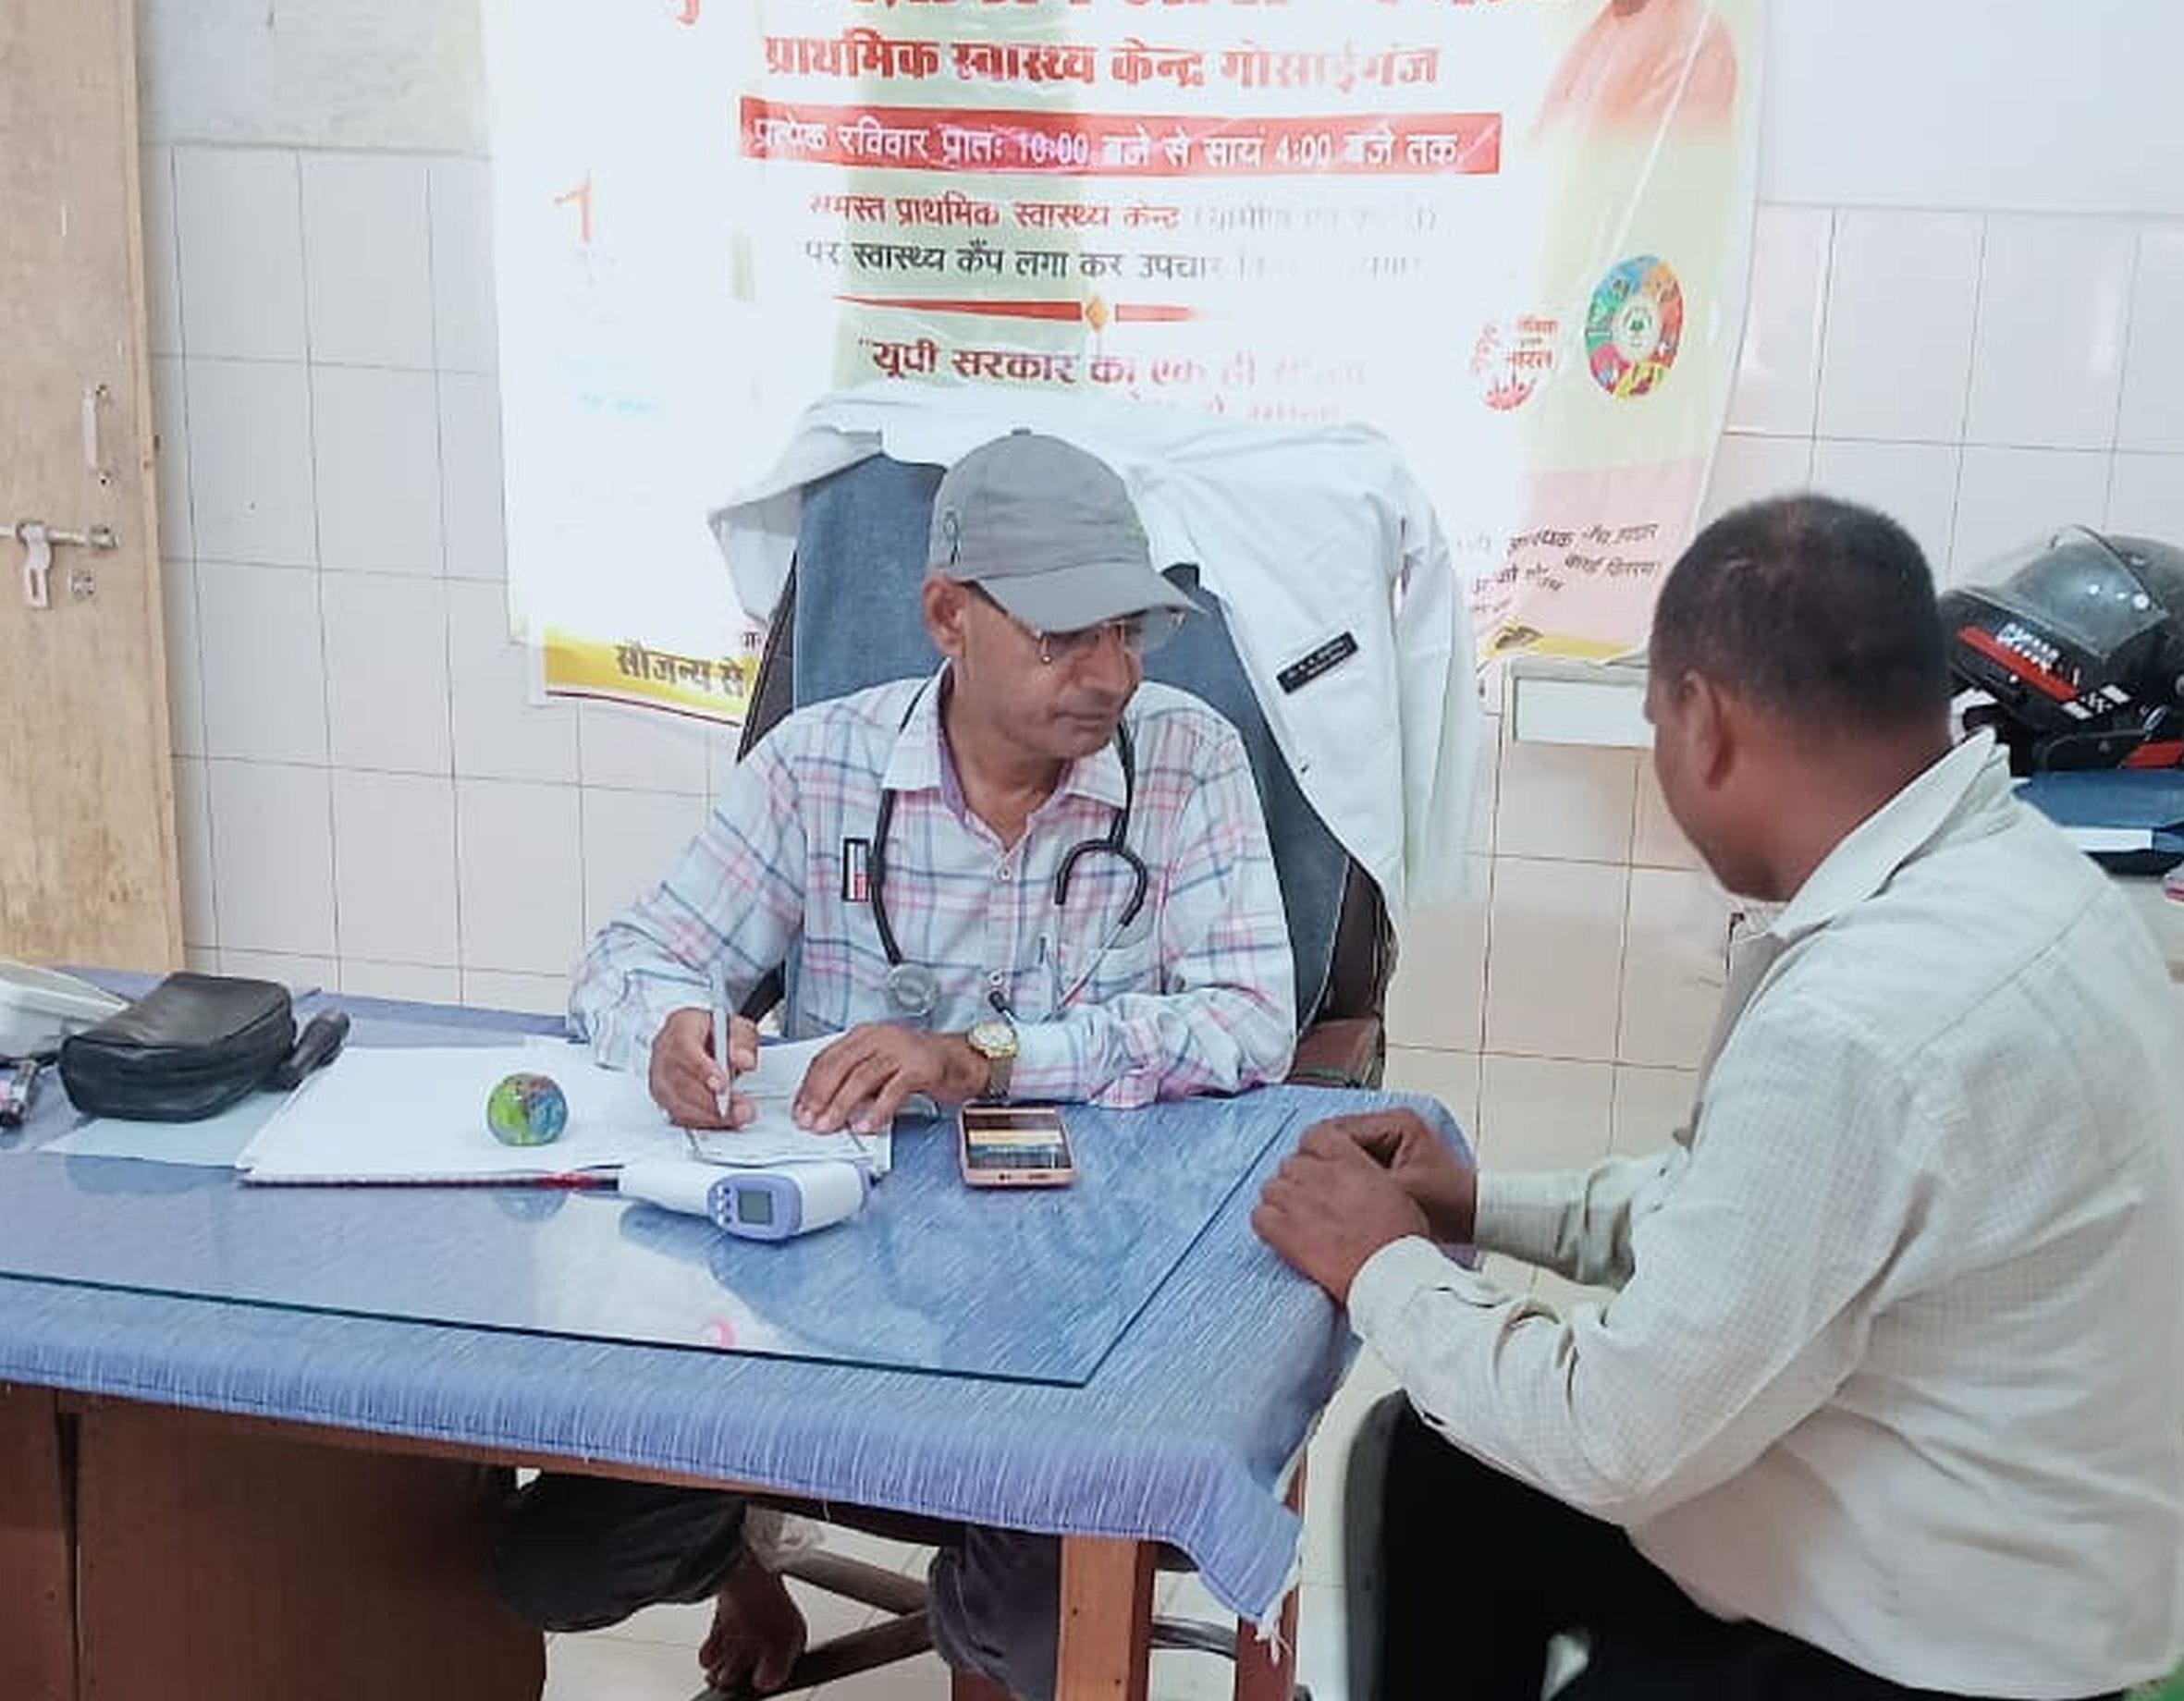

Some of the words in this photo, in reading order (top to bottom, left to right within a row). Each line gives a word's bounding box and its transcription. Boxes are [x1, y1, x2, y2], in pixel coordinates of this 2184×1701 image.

[765, 29, 939, 80] प्राथमिक
[951, 42, 1095, 83] स्वास्थ्य
[1111, 38, 1205, 88] केन्द्र
[837, 115, 928, 156] रविवार
[1016, 130, 1088, 165] 10:00
[1100, 124, 1150, 166] बजे
[1161, 127, 1190, 166] से
[1204, 127, 1265, 167] सायं
[1275, 134, 1331, 167] 4:00
[1343, 124, 1393, 166] बजे
[1406, 131, 1459, 165] तक
[809, 193, 885, 225] समस्त
[896, 190, 1000, 226] प्राथमिक
[1014, 201, 1109, 227] स्वास्थ्य
[805, 240, 839, 266] पर
[853, 241, 945, 272] स्वास्थ्य
[1016, 251, 1067, 277] लगा
[1080, 251, 1123, 277] कर
[951, 349, 1080, 385] सरकार
